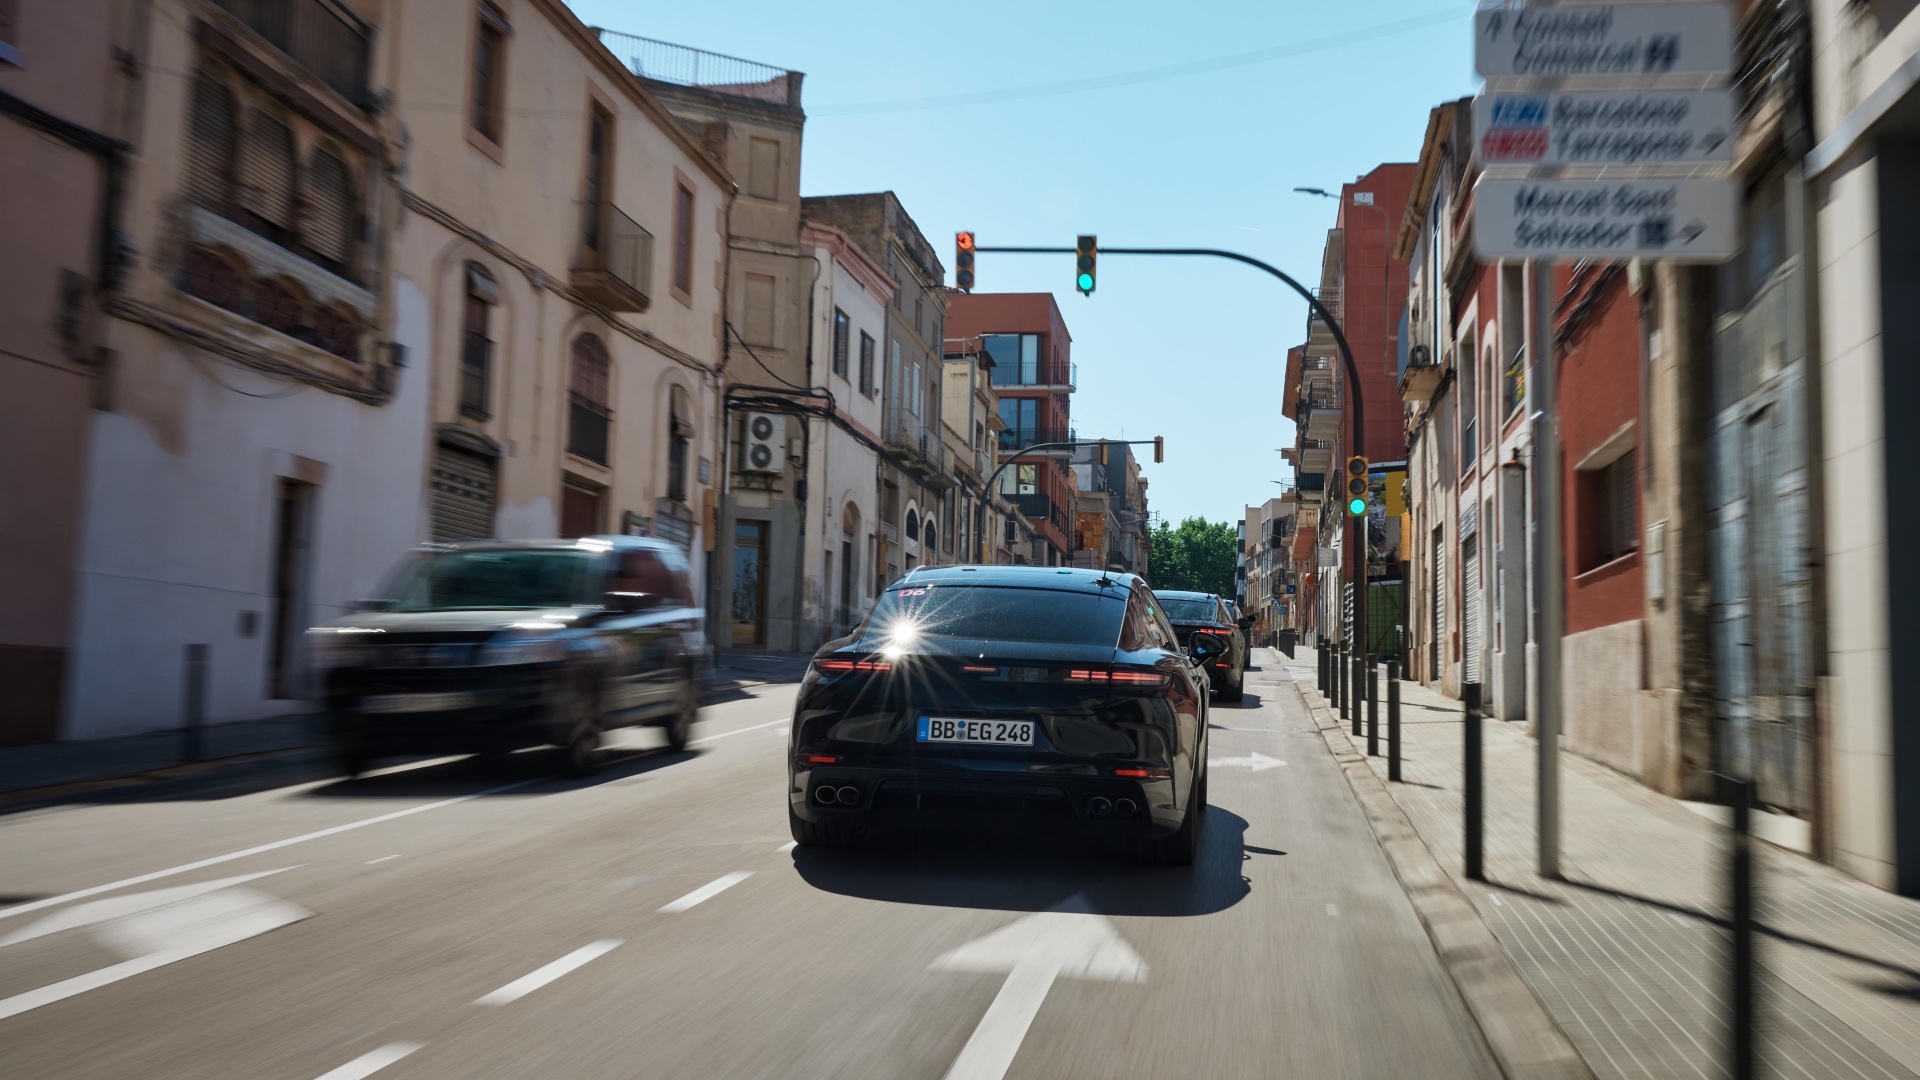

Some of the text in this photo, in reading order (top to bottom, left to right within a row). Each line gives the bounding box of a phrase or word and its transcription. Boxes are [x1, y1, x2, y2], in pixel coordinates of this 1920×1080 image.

[1553, 97, 1690, 128] Barcelona
[1553, 130, 1694, 162] Tarragona
[1514, 184, 1677, 217] Mercat Sant
[1514, 217, 1634, 249] Salvador
[898, 589, 925, 597] D6
[931, 721, 955, 739] BB
[967, 722, 991, 741] EG
[995, 723, 1031, 742] 248
